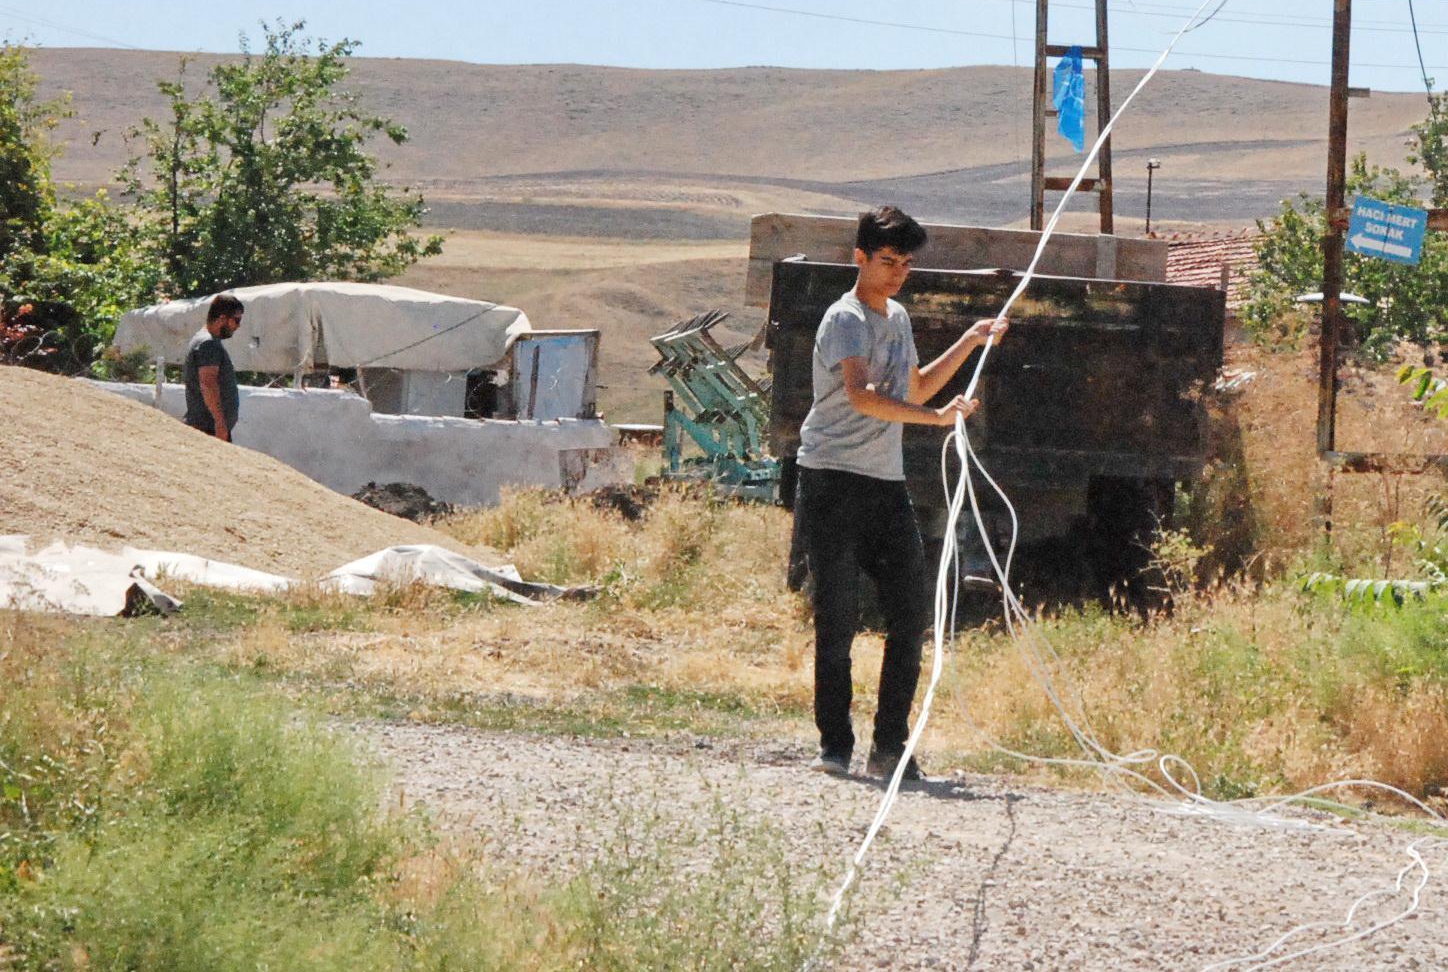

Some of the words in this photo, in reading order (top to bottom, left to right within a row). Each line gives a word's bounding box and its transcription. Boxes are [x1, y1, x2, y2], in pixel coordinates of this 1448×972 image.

[1357, 207, 1385, 220] HACI
[1387, 213, 1418, 229] MERT
[1366, 222, 1404, 240] SOKAK
